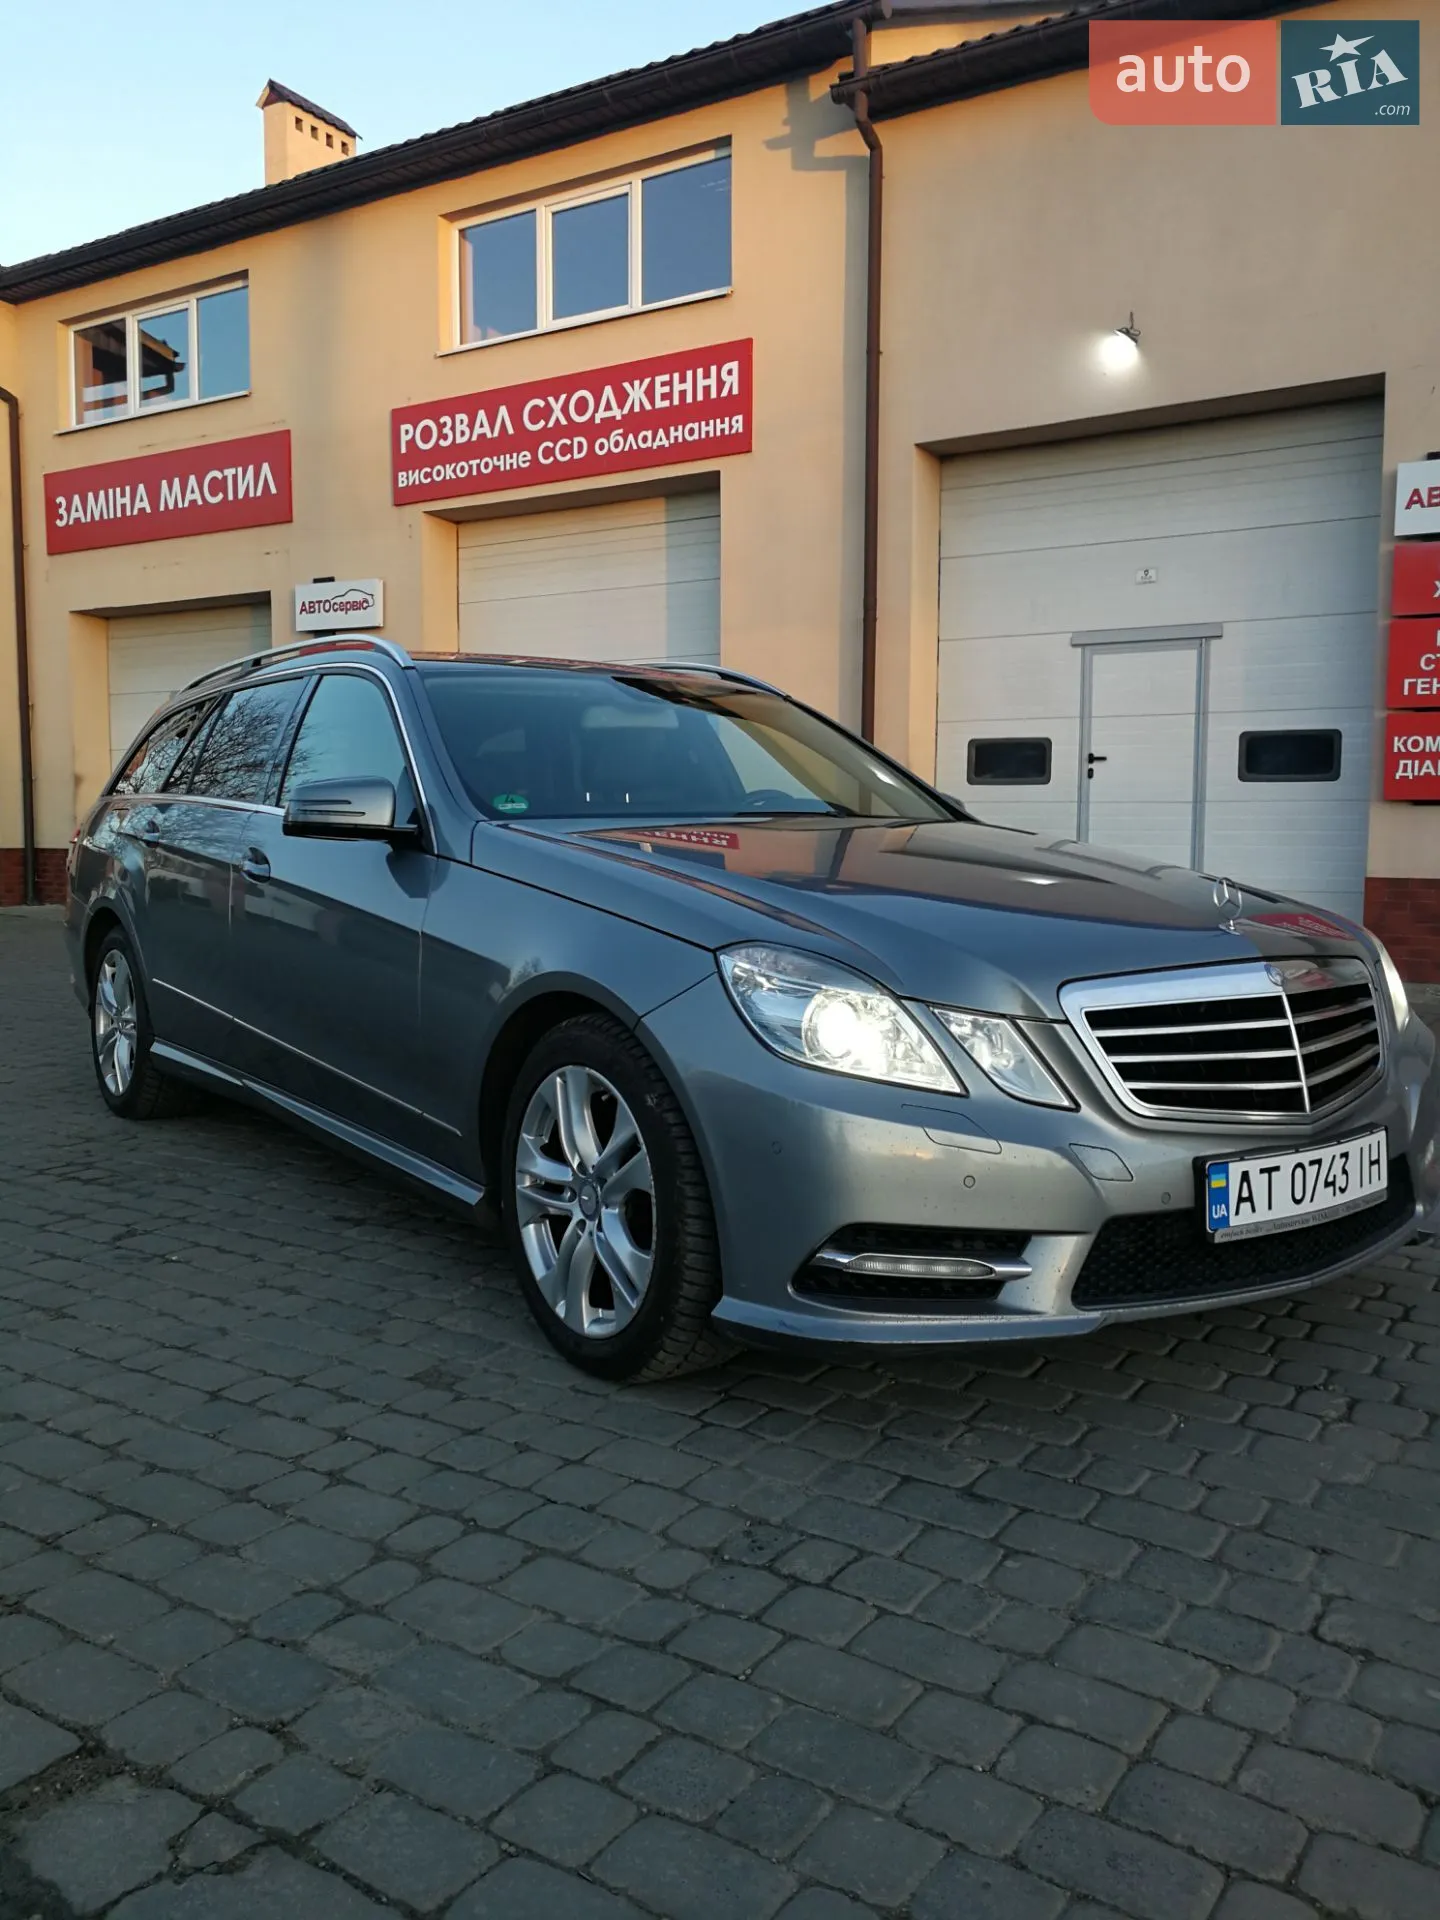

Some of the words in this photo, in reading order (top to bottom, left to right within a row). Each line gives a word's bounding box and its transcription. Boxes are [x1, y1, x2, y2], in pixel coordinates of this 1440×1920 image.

[399, 405, 514, 454] РОЗВАЛ
[523, 360, 740, 431] СХОДЖЕННЯ
[397, 450, 532, 488] високоточне
[537, 436, 588, 465] CCD
[594, 413, 744, 457] обладнання
[55, 483, 151, 528] ЗАМІНА
[159, 462, 277, 512] МАСТИЛ
[1395, 759, 1440, 780] ДІА
[1212, 1203, 1228, 1219] UA
[1234, 1165, 1281, 1217] AT
[1290, 1151, 1350, 1205] 0743
[1359, 1140, 1381, 1188] IH
